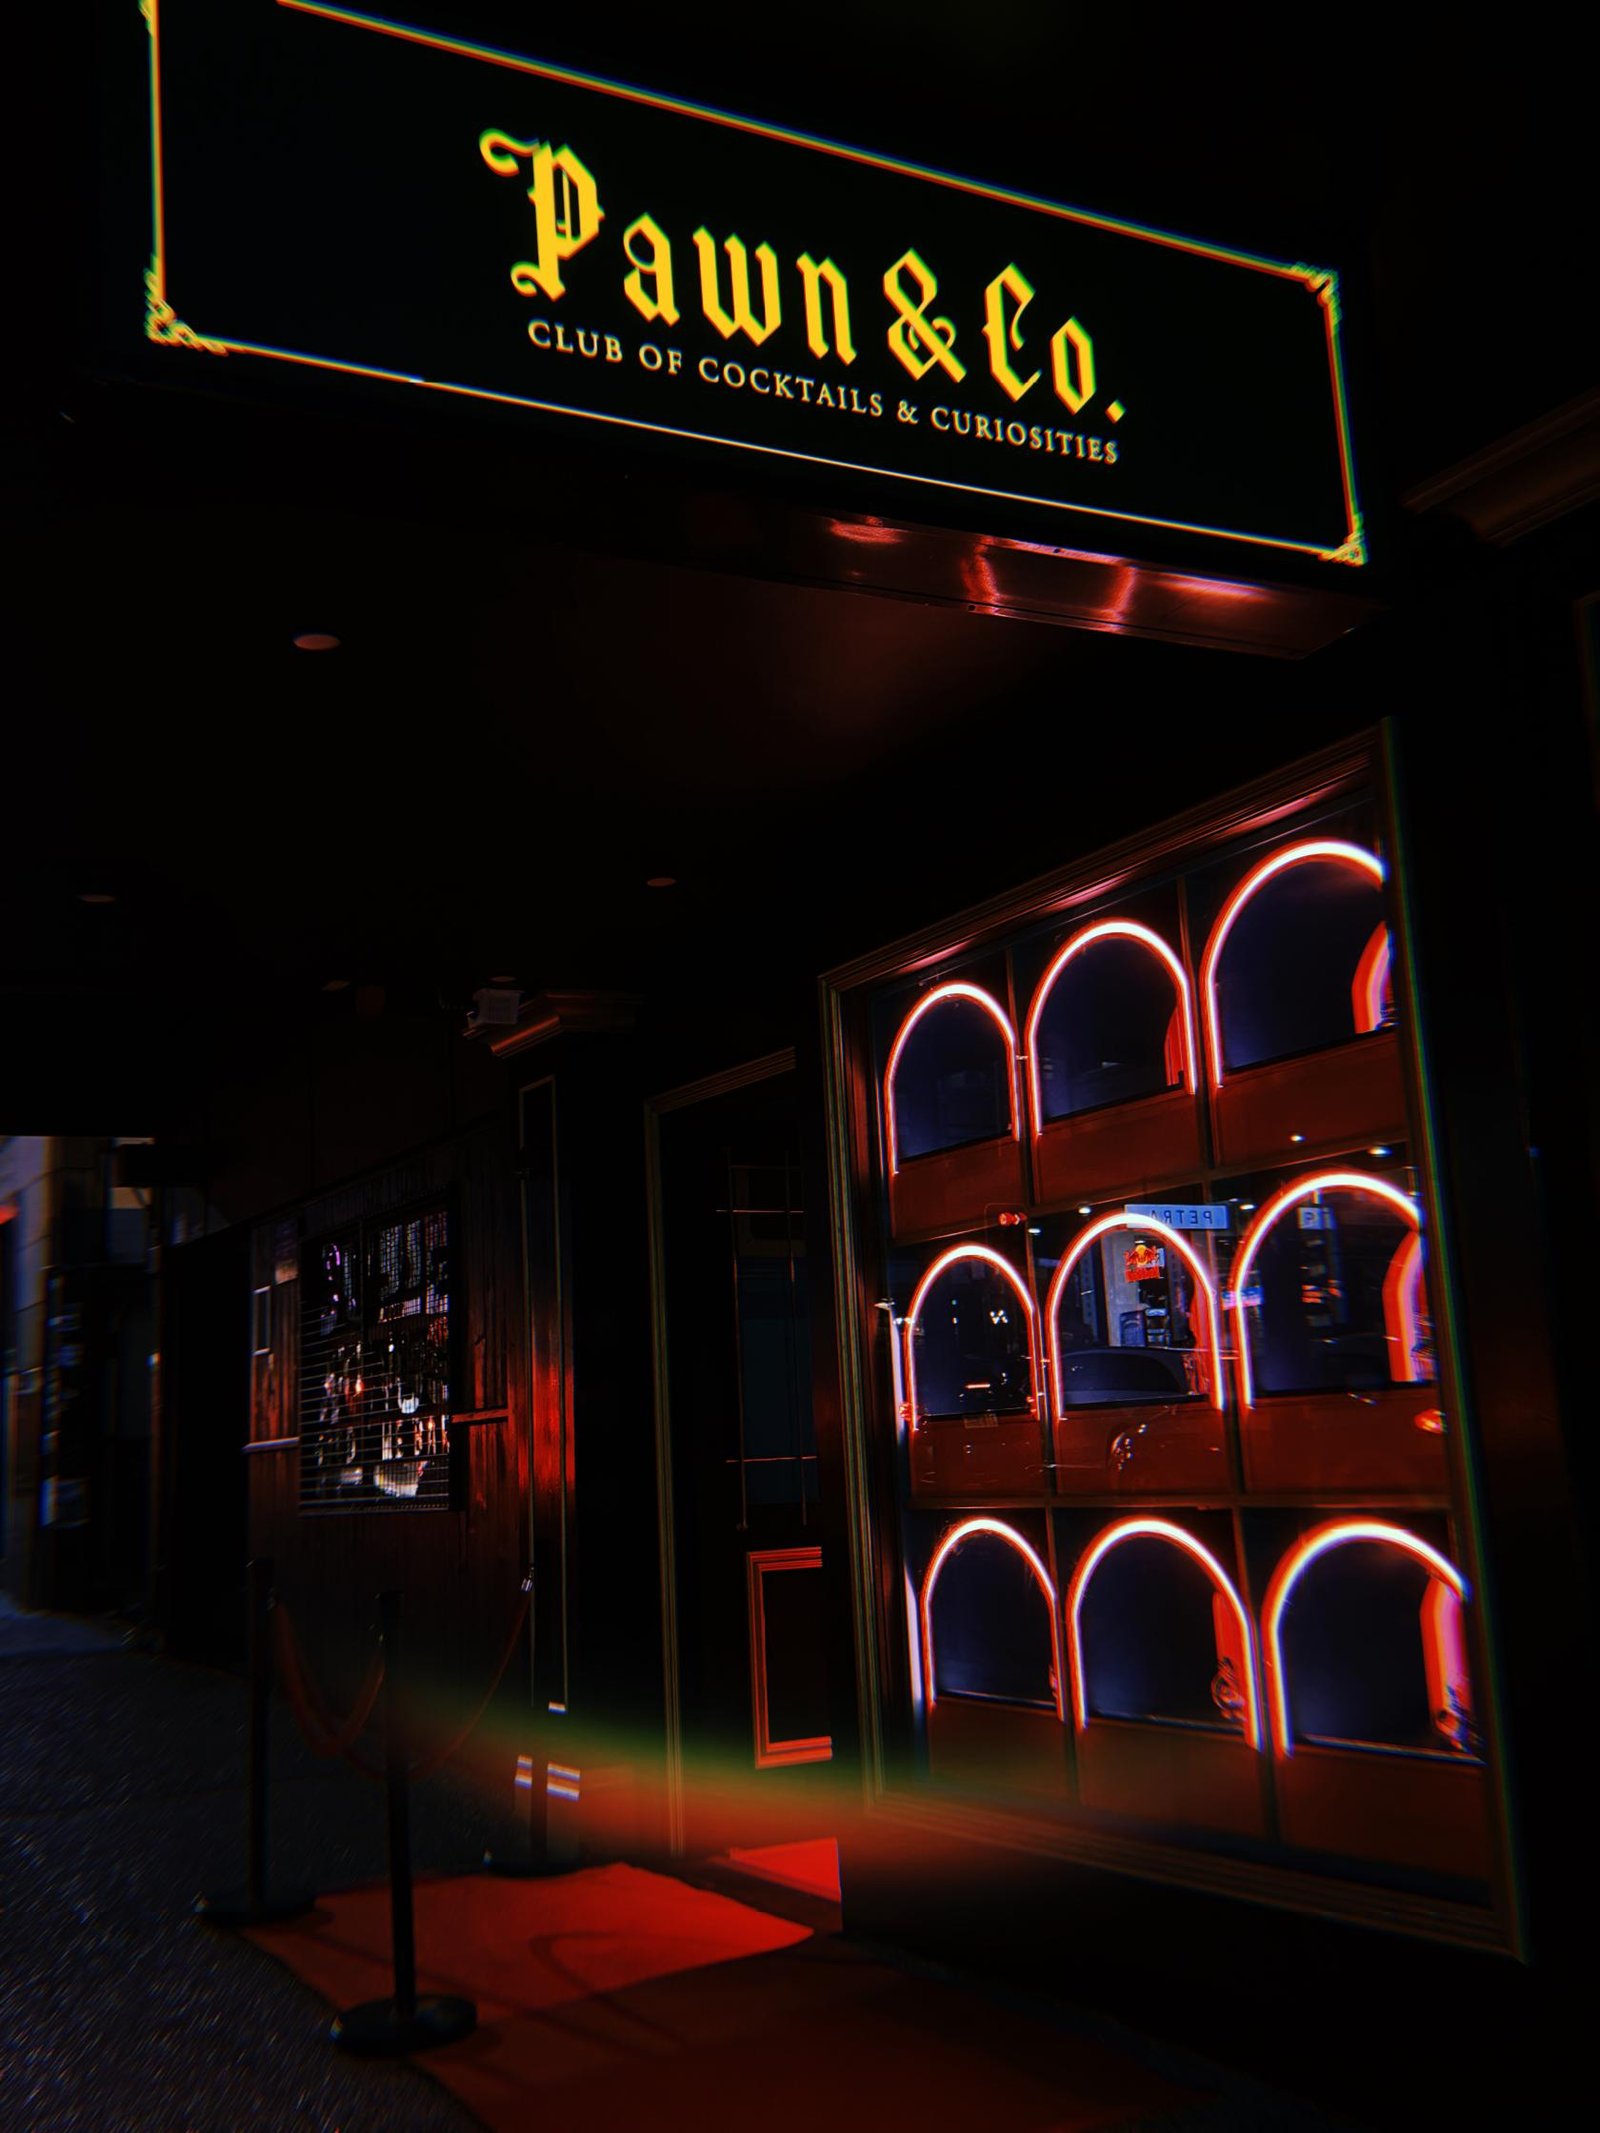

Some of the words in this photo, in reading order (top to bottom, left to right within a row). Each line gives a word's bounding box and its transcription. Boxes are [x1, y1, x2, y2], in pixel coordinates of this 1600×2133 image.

[527, 319, 623, 363] CLUB
[638, 343, 683, 376] OF
[698, 356, 884, 417] COCKTAILS
[896, 399, 919, 425] &
[930, 406, 1119, 465] CURIOSITIES
